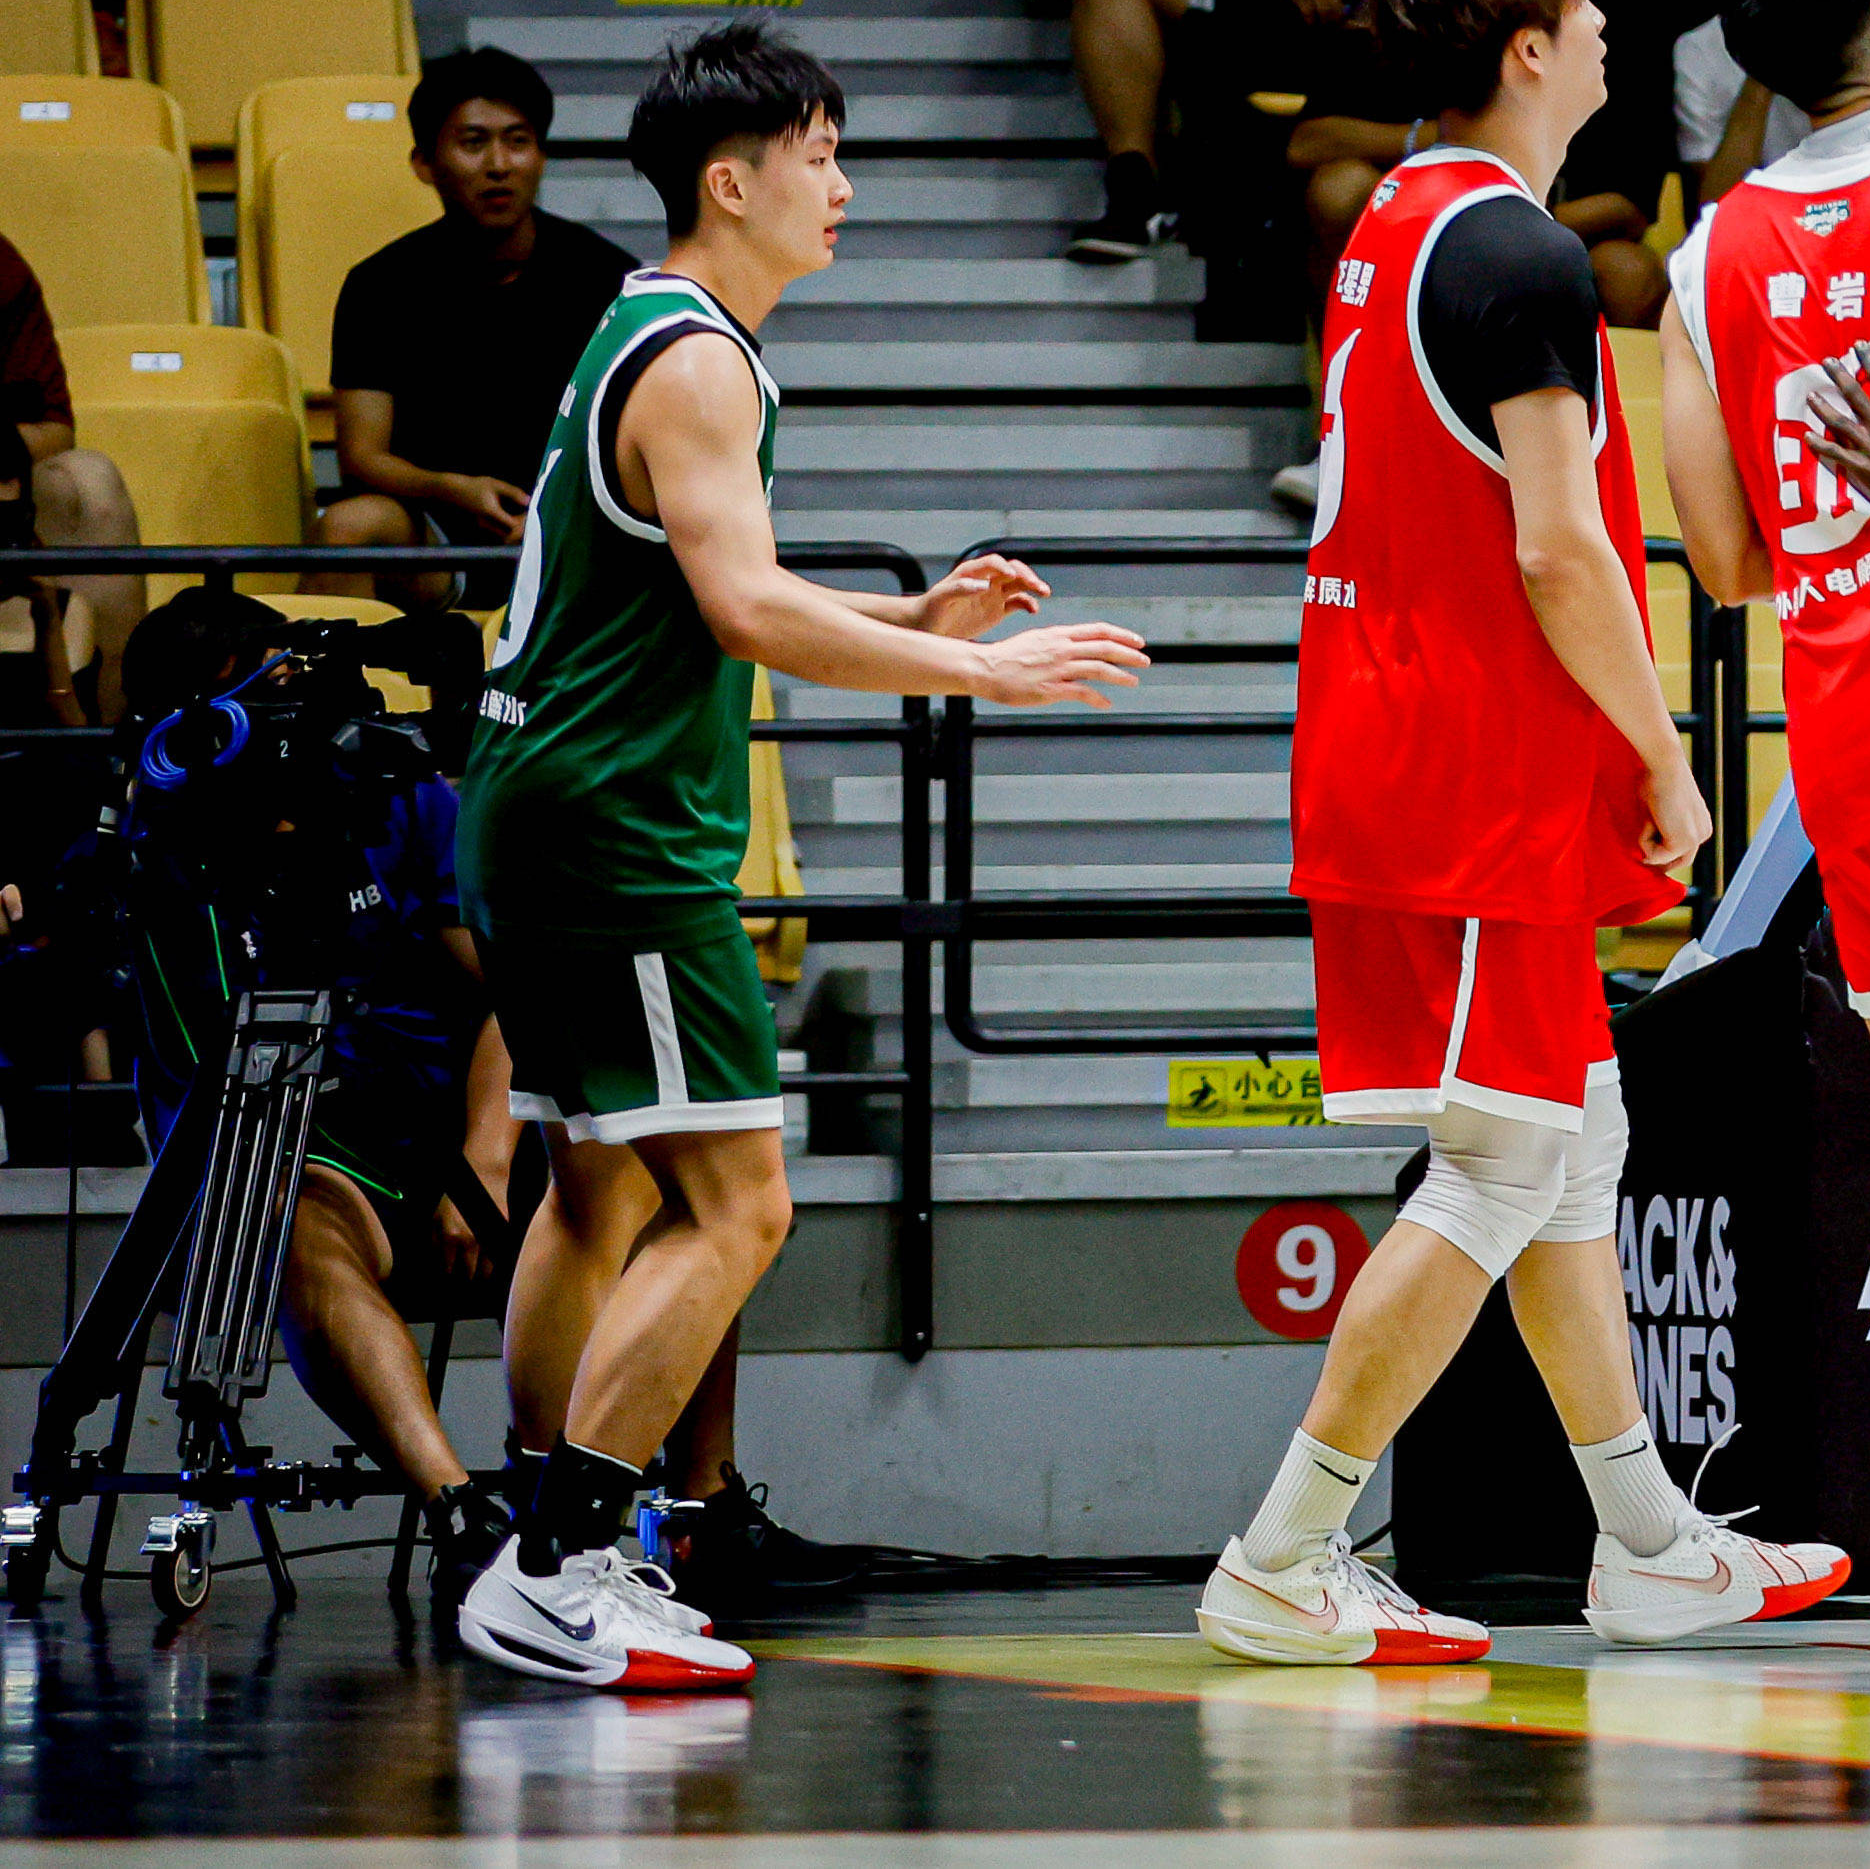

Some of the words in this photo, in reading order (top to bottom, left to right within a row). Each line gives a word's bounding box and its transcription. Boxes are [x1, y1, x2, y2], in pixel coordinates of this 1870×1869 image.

[280, 740, 290, 758] 2
[349, 884, 382, 913] HB
[1234, 1069, 1321, 1100] 小心台
[1275, 1223, 1336, 1312] 9
